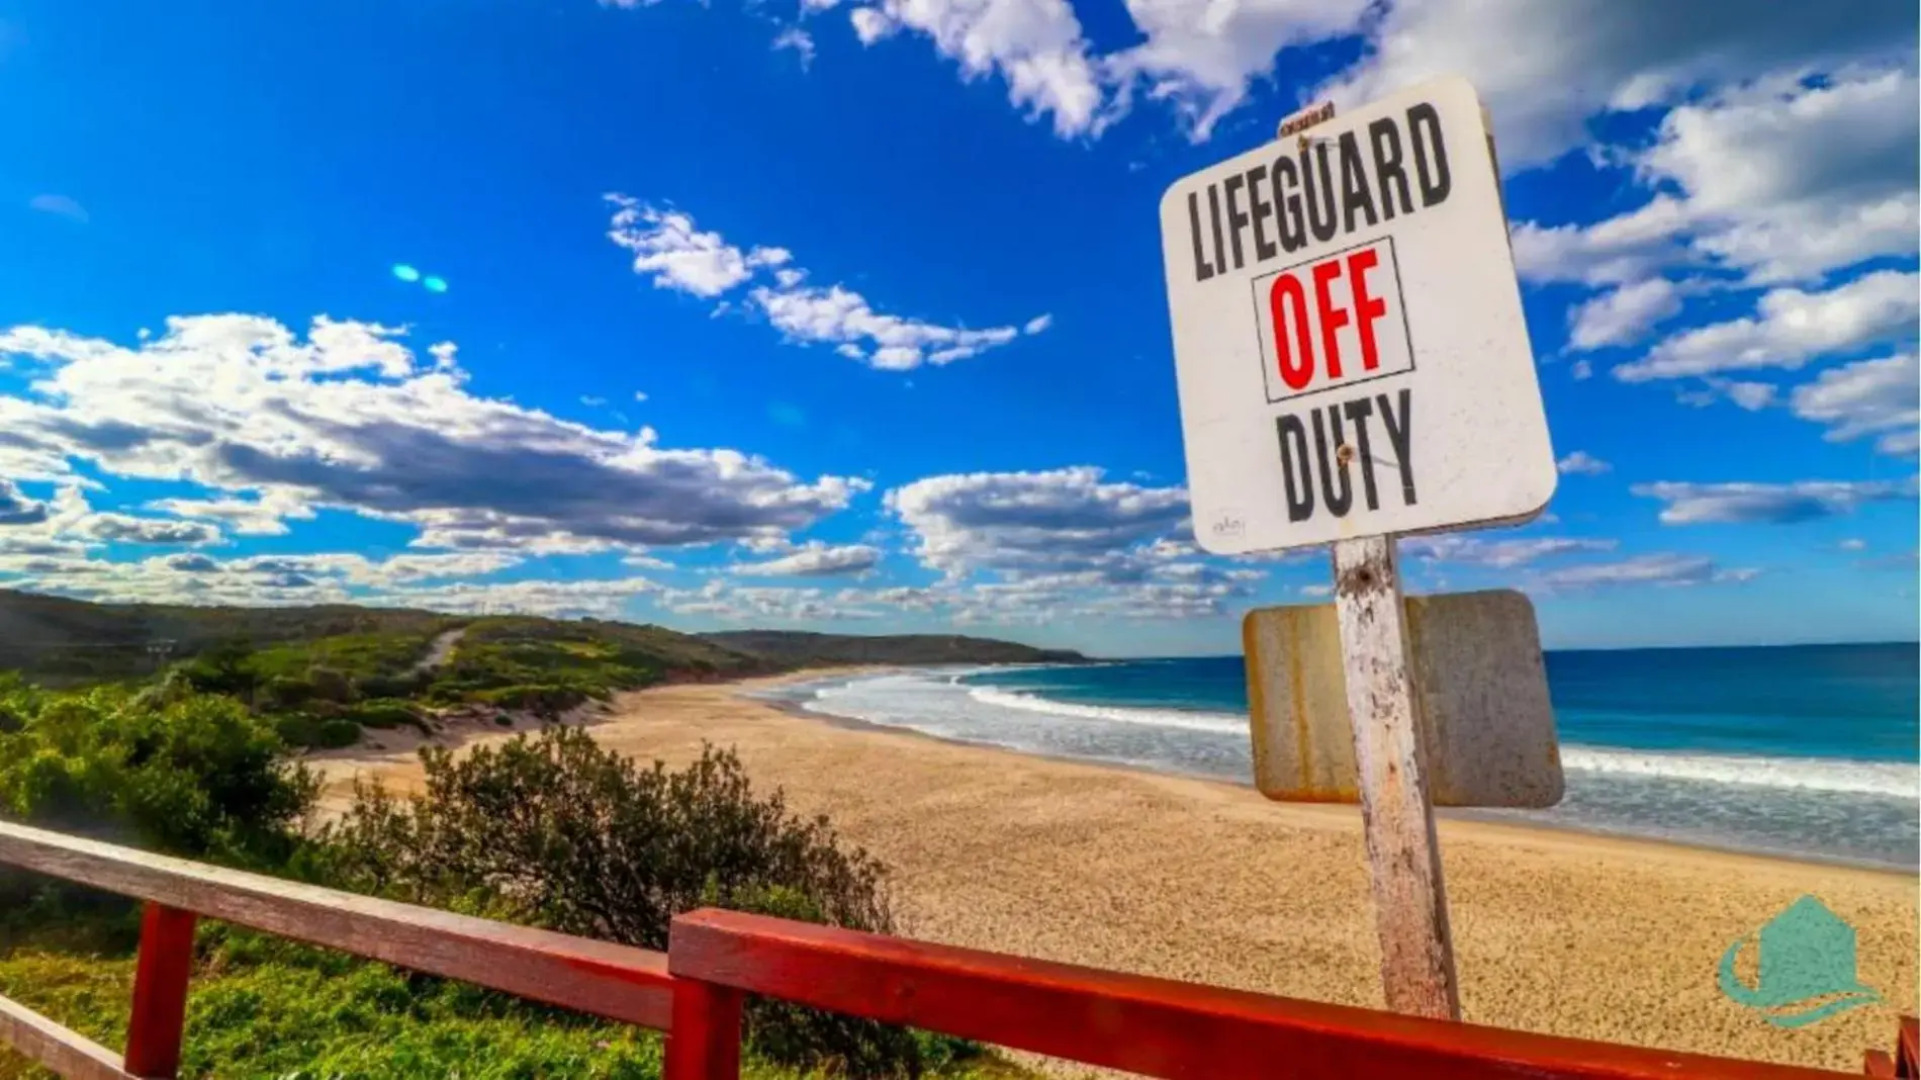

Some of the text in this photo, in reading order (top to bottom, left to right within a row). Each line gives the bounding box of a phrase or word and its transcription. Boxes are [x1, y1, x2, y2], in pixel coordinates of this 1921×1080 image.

[1188, 102, 1452, 282] LIFEGUARD
[1269, 248, 1386, 390] OFF
[1276, 389, 1417, 523] DUTY
